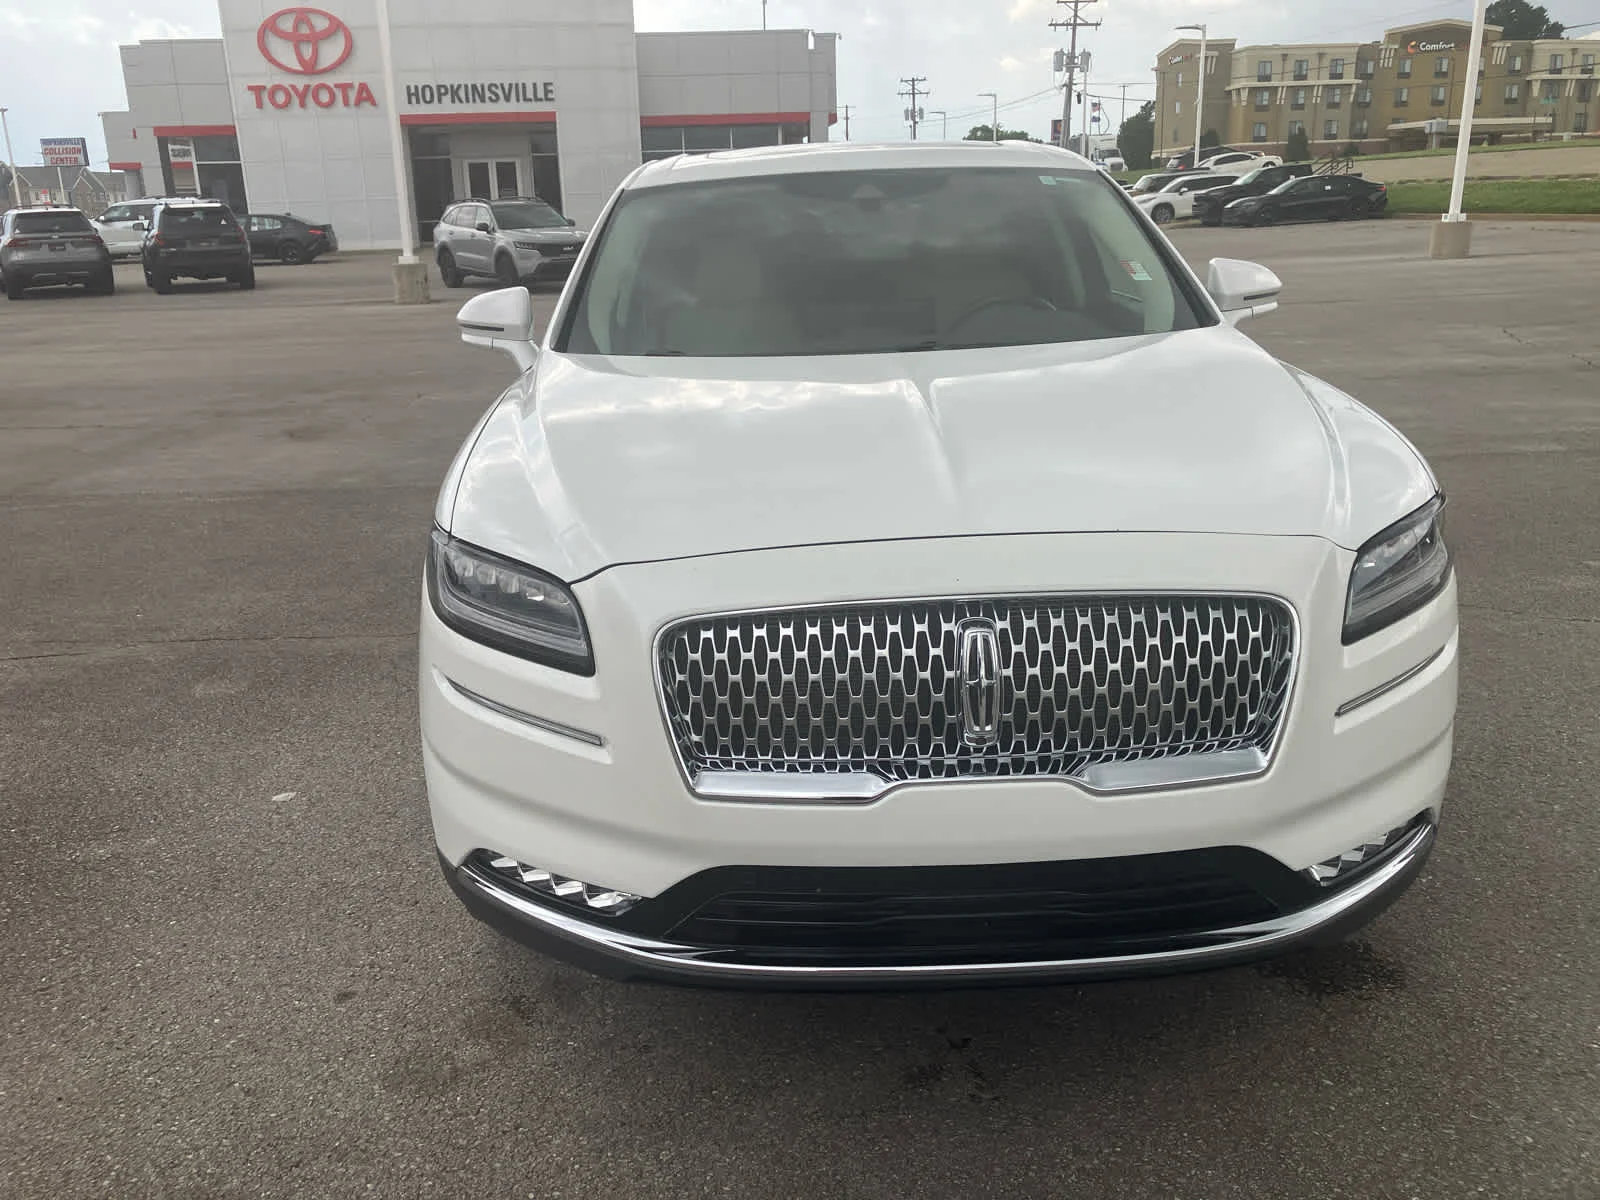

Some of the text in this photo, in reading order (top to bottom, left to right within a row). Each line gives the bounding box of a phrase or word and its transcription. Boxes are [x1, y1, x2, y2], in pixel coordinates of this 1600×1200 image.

[247, 82, 377, 109] TOYOTA
[406, 82, 555, 105] HOPKINSVILLE
[44, 147, 82, 156] COLLISION
[51, 156, 78, 164] CENTER
